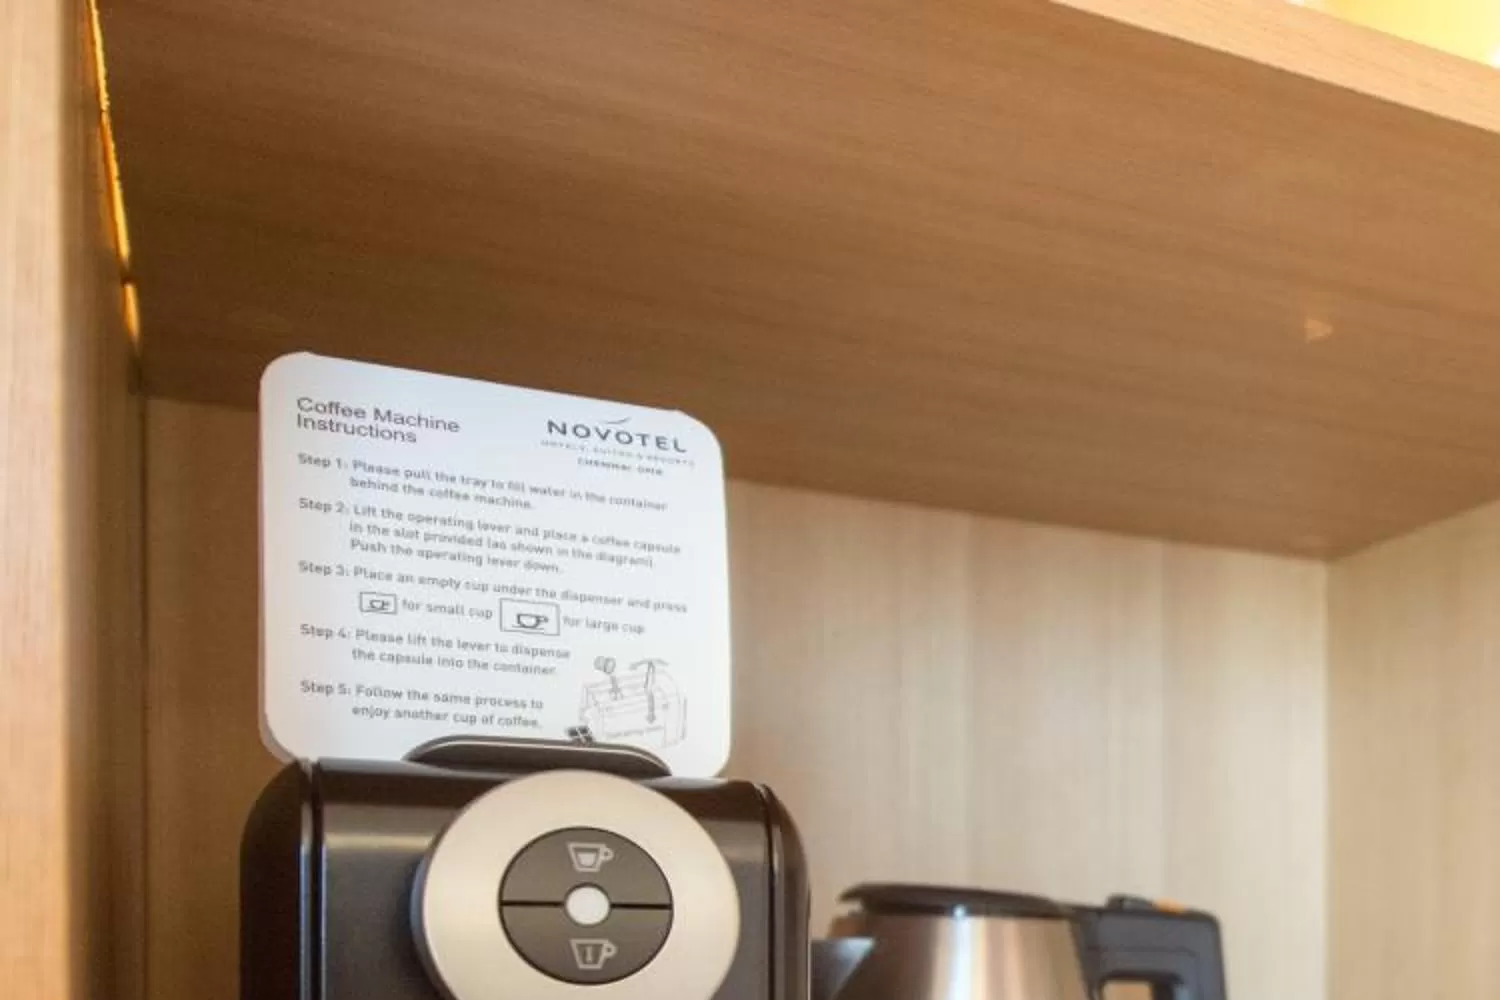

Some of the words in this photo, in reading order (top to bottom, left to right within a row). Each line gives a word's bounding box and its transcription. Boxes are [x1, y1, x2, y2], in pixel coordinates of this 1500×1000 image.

[297, 397, 366, 419] Coffee
[374, 407, 460, 432] Machine
[297, 413, 417, 443] Instructions
[546, 419, 687, 452] NOVOTEL
[298, 453, 330, 468] Step
[352, 460, 400, 476] Please
[404, 467, 430, 481] pull
[435, 472, 456, 484] the
[461, 475, 486, 488] tray
[491, 479, 504, 490] to
[508, 481, 525, 493] fill
[529, 485, 566, 497] water
[570, 490, 582, 501] in
[585, 491, 606, 504] the
[609, 495, 668, 511] container
[351, 477, 399, 493] behind
[403, 484, 424, 496] the
[429, 488, 470, 502] coffee
[299, 498, 332, 513] Step
[354, 504, 377, 517] Lift
[381, 507, 403, 521] the
[407, 513, 474, 531] operating
[477, 520, 511, 534] lever
[515, 525, 539, 537] and
[543, 528, 577, 543] place
[592, 535, 630, 548] coffee
[633, 539, 681, 554] capsule
[350, 520, 362, 533] in
[367, 523, 389, 537] the
[394, 526, 419, 540] slot
[423, 532, 482, 548] provided
[511, 539, 553, 556] shown
[557, 545, 568, 556] in
[572, 546, 593, 560] the
[351, 538, 386, 554] Push
[391, 544, 413, 557] the
[418, 548, 482, 567] operating
[487, 556, 521, 569] lever
[298, 560, 332, 576] Step
[353, 565, 393, 582] Place
[397, 573, 414, 583] an
[418, 575, 461, 590] empty
[465, 581, 489, 593] cup
[493, 580, 532, 596] under
[536, 585, 557, 600] the
[560, 589, 624, 607] dispenser
[628, 597, 650, 610] and
[653, 601, 688, 613] press
[402, 599, 420, 612] for
[427, 602, 464, 617] small
[469, 608, 493, 620] cup
[562, 616, 581, 629] for
[585, 617, 619, 633] large
[622, 623, 645, 636] cup
[300, 623, 333, 640] Step
[355, 628, 403, 645] Please
[407, 633, 426, 647] lift
[431, 636, 453, 649] the
[457, 639, 489, 652] lever
[494, 642, 508, 653] to
[511, 643, 570, 660] dispense
[352, 648, 375, 661] the
[379, 652, 433, 666] capsule
[438, 655, 463, 669] into
[467, 658, 489, 671] the
[300, 680, 334, 695] Step
[355, 684, 403, 698] Follow
[407, 688, 428, 702] the
[434, 692, 470, 705] same
[475, 695, 527, 710] process
[530, 699, 543, 710] to
[352, 705, 391, 720] enjoy
[394, 707, 448, 722] another
[453, 713, 477, 726] cup
[481, 714, 495, 726] of
